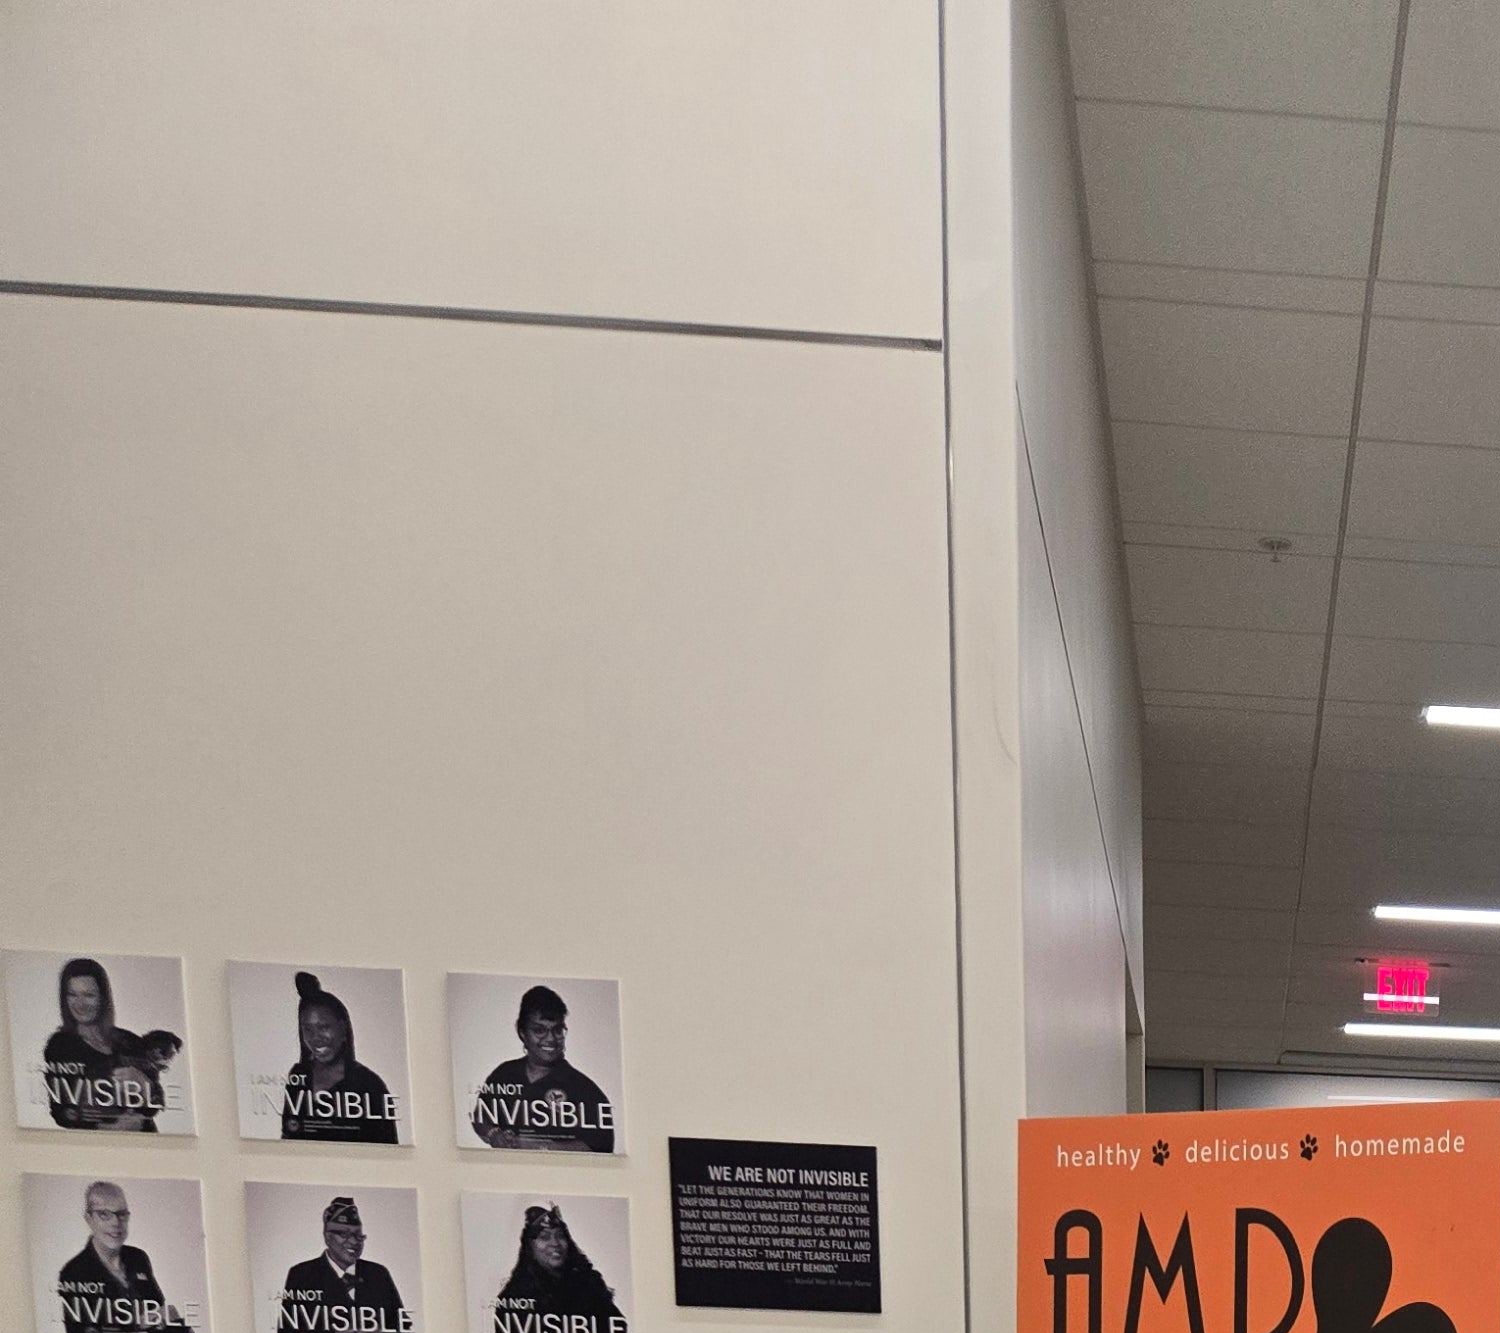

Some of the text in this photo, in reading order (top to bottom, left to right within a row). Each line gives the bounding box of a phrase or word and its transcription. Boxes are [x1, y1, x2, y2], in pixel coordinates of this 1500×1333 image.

[1377, 967, 1429, 1013] EXIT
[57, 1063, 86, 1075] NOT
[32, 1075, 184, 1111] NVISIBLE
[497, 1083, 524, 1095] NOT
[1056, 1129, 1465, 1171] healthy delicious homemade
[708, 1165, 869, 1187] WE ARE NOT INVISIBLE
[699, 1185, 715, 1195] THE
[717, 1186, 775, 1197] GENERATIONS
[776, 1188, 802, 1198] KNOW
[804, 1189, 825, 1200] THAT
[826, 1191, 859, 1201] WOMEN
[860, 1192, 870, 1202] IN
[720, 1198, 742, 1209] ALSO
[744, 1200, 800, 1211] GUARANTEED
[802, 1202, 827, 1212] THEIR
[679, 1209, 870, 1226] THAT OUR RESOLVE WAS JUST AS GREAT AS THE
[709, 1222, 728, 1232] MEN
[729, 1223, 750, 1233] WHO
[751, 1224, 780, 1235] STOOD
[781, 1225, 812, 1236] AMONG
[829, 1227, 846, 1238] AND
[848, 1228, 870, 1238] WITH
[680, 1233, 871, 1251] VICTORY OUR HEARTS WERE JUST AS FULL AND
[680, 1245, 871, 1263] BEAT JUST AS FAST THAT THE TEARS FELL JUST
[682, 1258, 693, 1268] AS
[694, 1258, 718, 1269] HARD
[720, 1259, 736, 1269] FOR
[738, 1260, 766, 1271] THOSE
[767, 1261, 780, 1272] WE
[781, 1262, 801, 1272] LEFT
[77, 1281, 106, 1294] NOT
[296, 1289, 324, 1301] NOT
[51, 1296, 200, 1328] NVISIBLE
[509, 1298, 536, 1310] NOT
[271, 1304, 416, 1333] NVISIBLE
